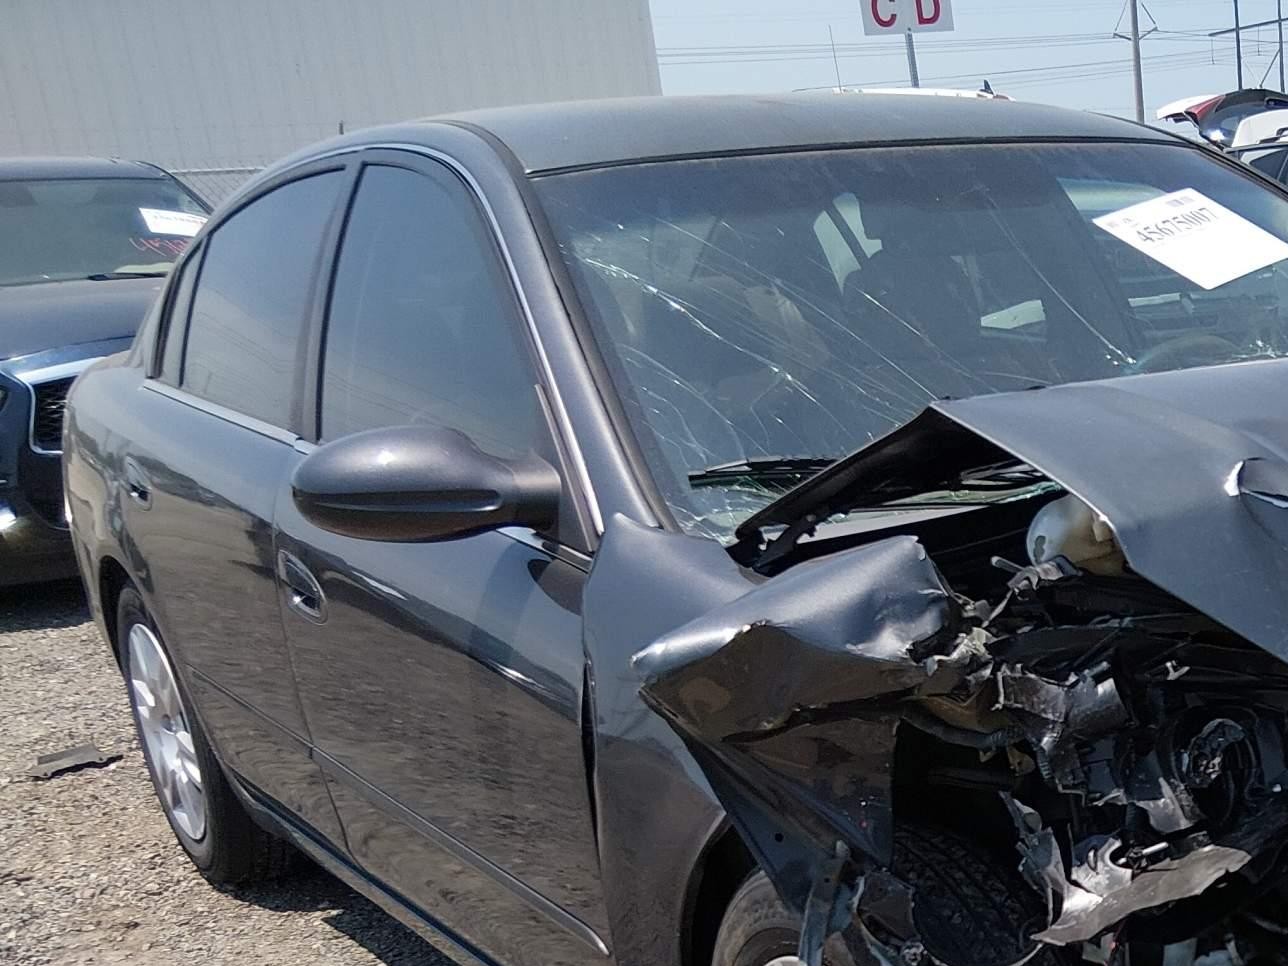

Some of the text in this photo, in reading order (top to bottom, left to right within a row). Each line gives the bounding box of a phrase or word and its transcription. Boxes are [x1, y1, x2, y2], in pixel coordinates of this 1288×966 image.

[871, 0, 941, 27] C D
[1136, 207, 1219, 243] 45675007
